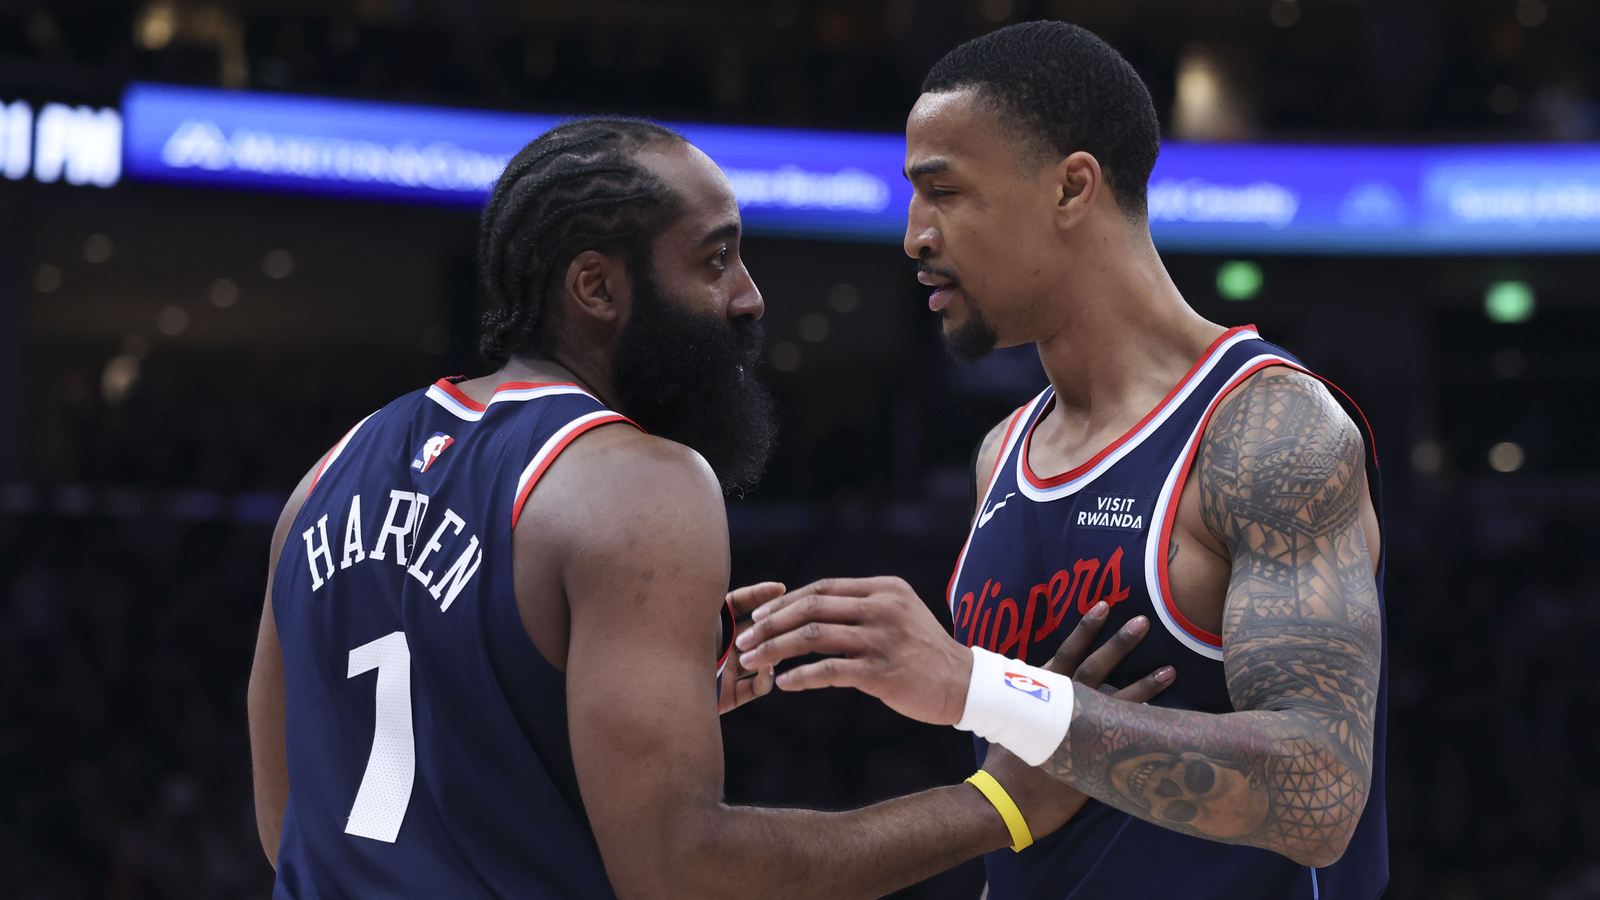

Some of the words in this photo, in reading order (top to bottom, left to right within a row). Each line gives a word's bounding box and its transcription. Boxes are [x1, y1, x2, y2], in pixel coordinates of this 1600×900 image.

[1097, 497, 1135, 512] VISIT
[1077, 511, 1142, 529] RWANDA
[344, 631, 416, 843] 1
